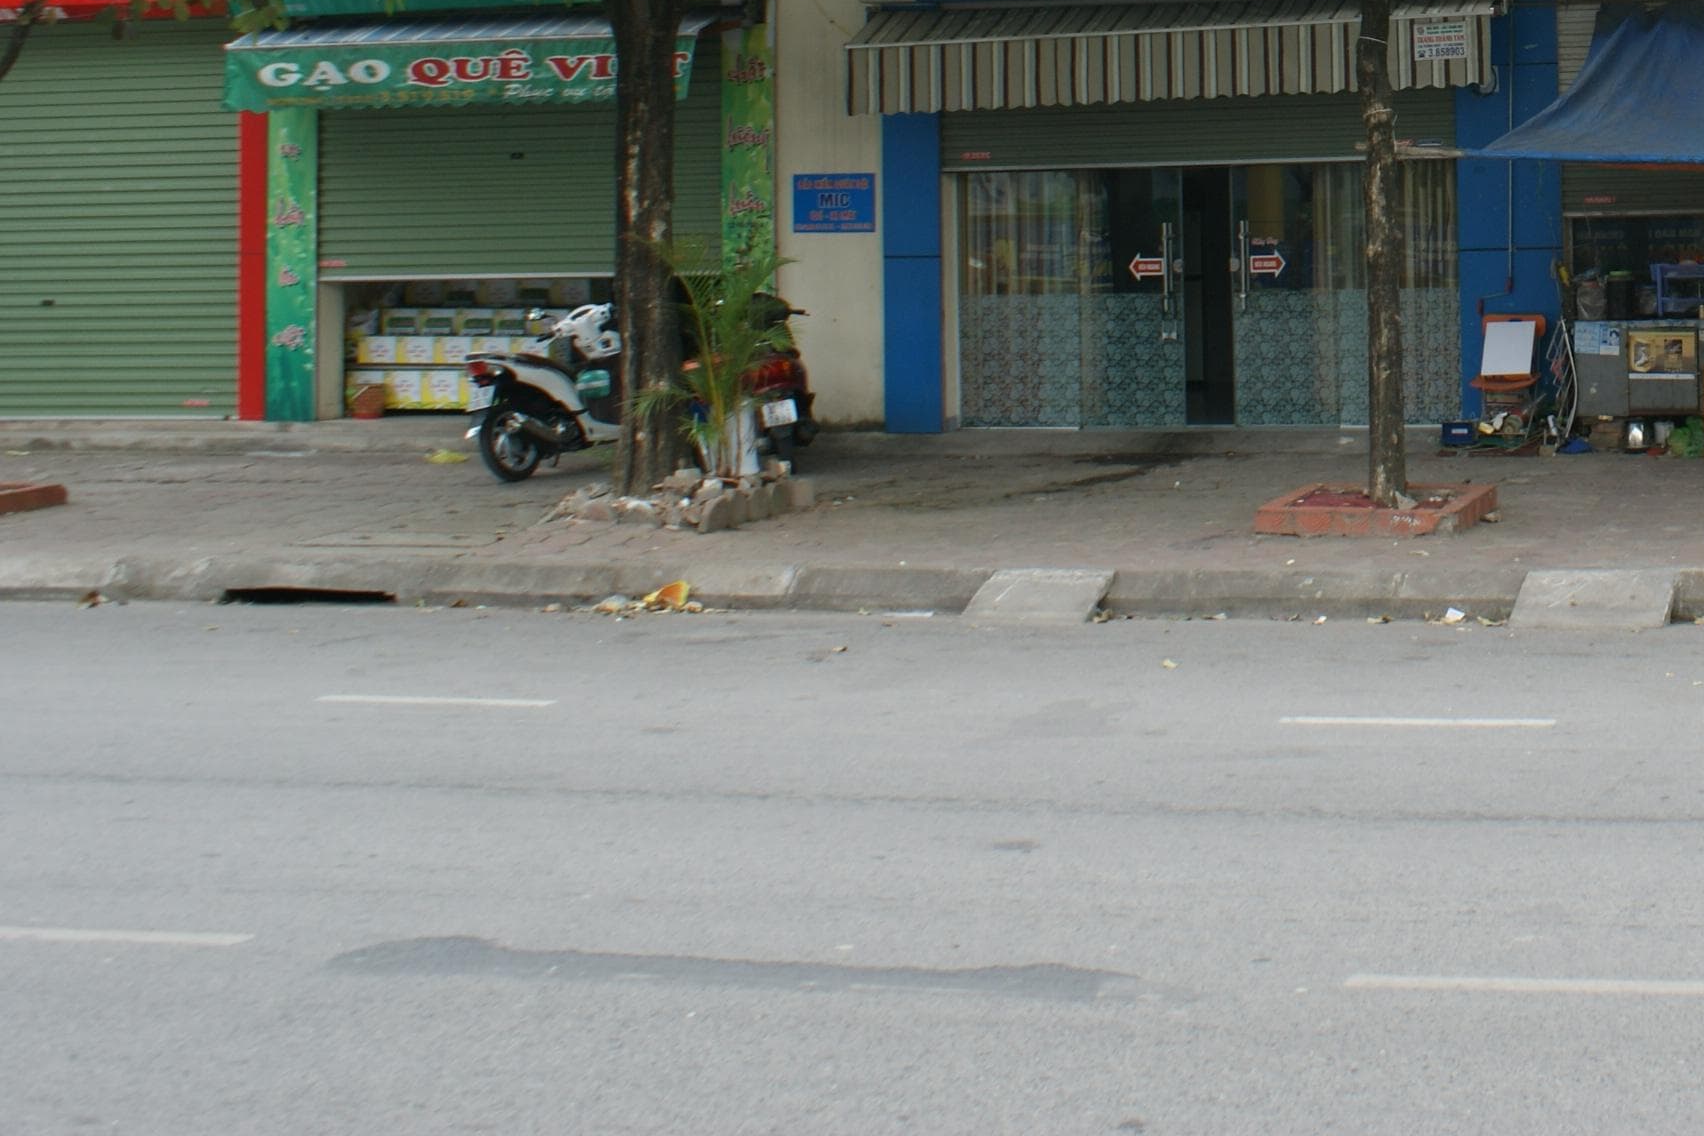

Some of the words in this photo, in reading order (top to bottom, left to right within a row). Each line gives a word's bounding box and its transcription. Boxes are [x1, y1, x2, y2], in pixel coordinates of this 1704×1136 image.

[257, 59, 392, 91] GẠO
[407, 48, 532, 88] QUÊ
[545, 51, 689, 82] VIT
[818, 192, 850, 209] MIC
